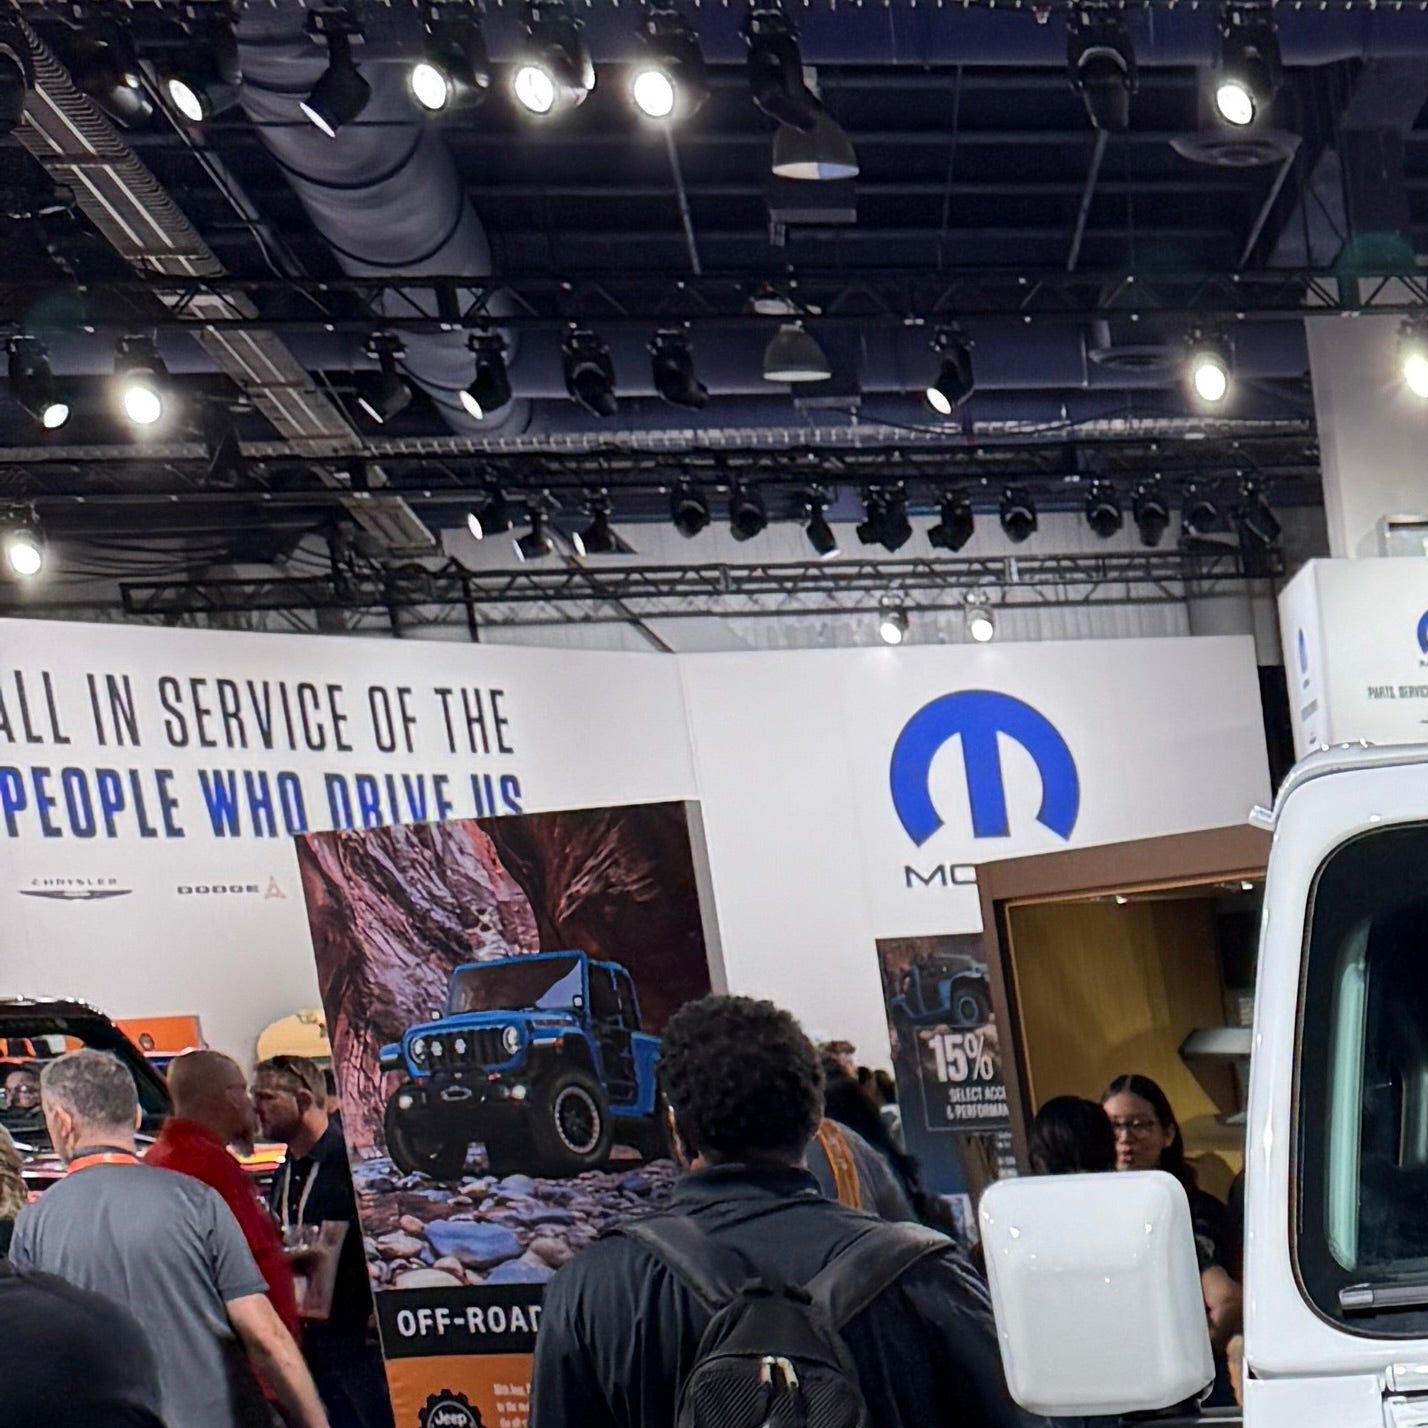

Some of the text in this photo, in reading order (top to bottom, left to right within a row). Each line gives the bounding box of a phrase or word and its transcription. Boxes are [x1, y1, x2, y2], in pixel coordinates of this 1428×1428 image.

[87, 673, 141, 747] IN
[158, 675, 354, 754] SERVICE
[368, 685, 416, 754] OF
[434, 687, 515, 755] THE
[0, 765, 186, 839] PEOPLE
[198, 769, 309, 838] WHO
[177, 885, 259, 895] DODGE
[928, 1033, 994, 1083] 15%
[949, 1086, 982, 1102] SELECT
[434, 1411, 468, 1427] Jeep
